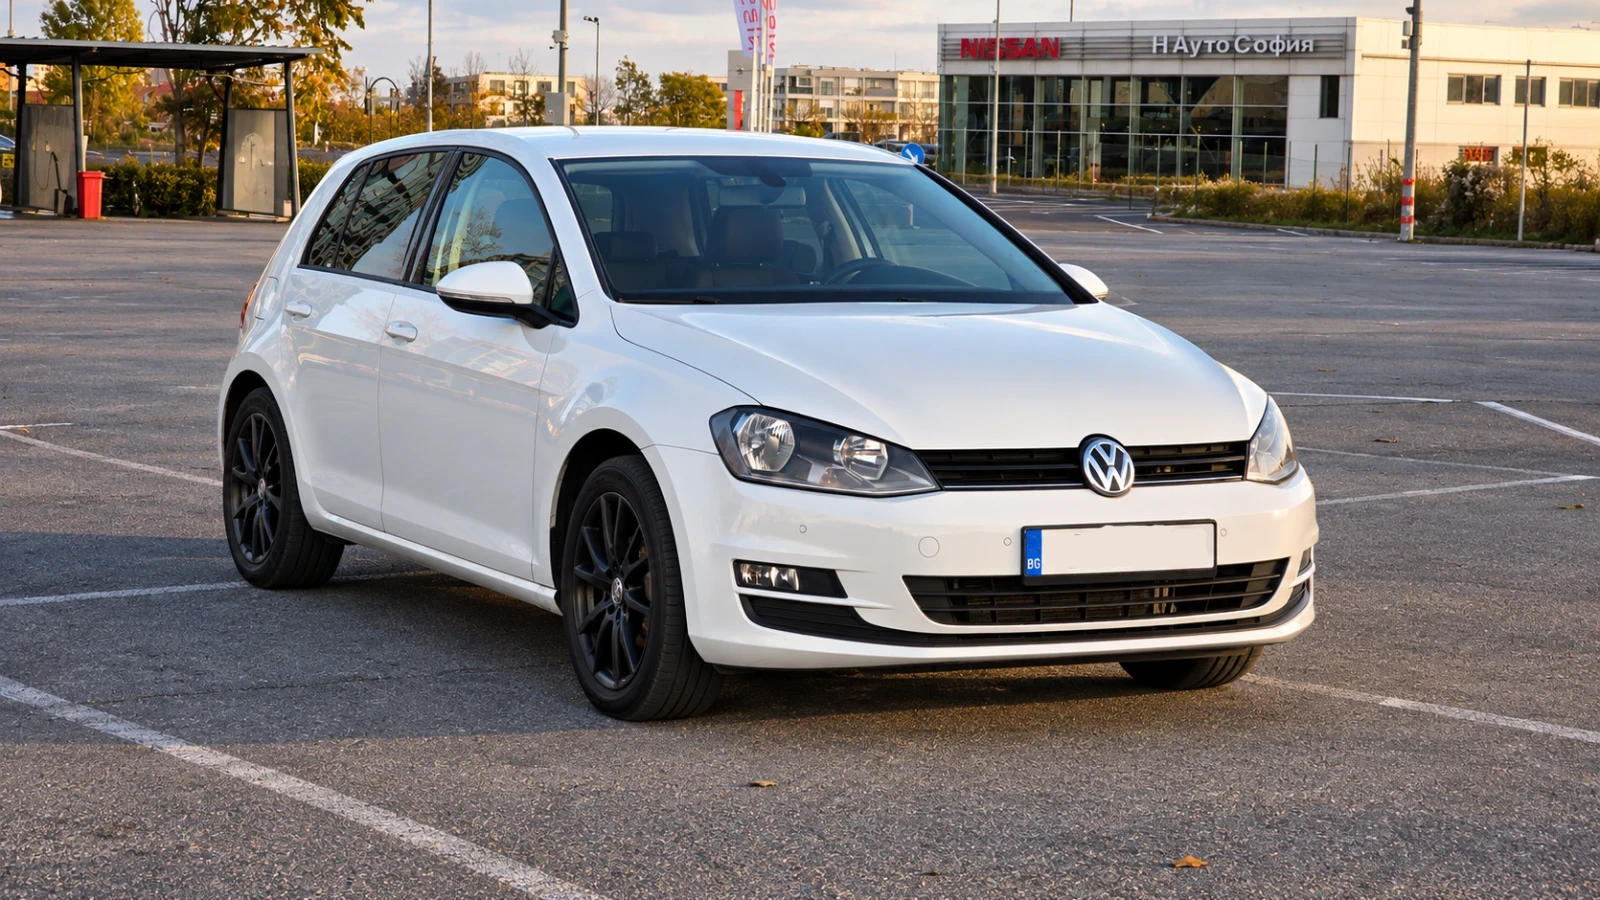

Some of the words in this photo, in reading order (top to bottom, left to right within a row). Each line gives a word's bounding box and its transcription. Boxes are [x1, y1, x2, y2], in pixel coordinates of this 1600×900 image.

[961, 37, 1060, 59] NISSAN
[1234, 34, 1315, 58] София
[1084, 439, 1135, 494] VW
[1027, 558, 1041, 569] BG
